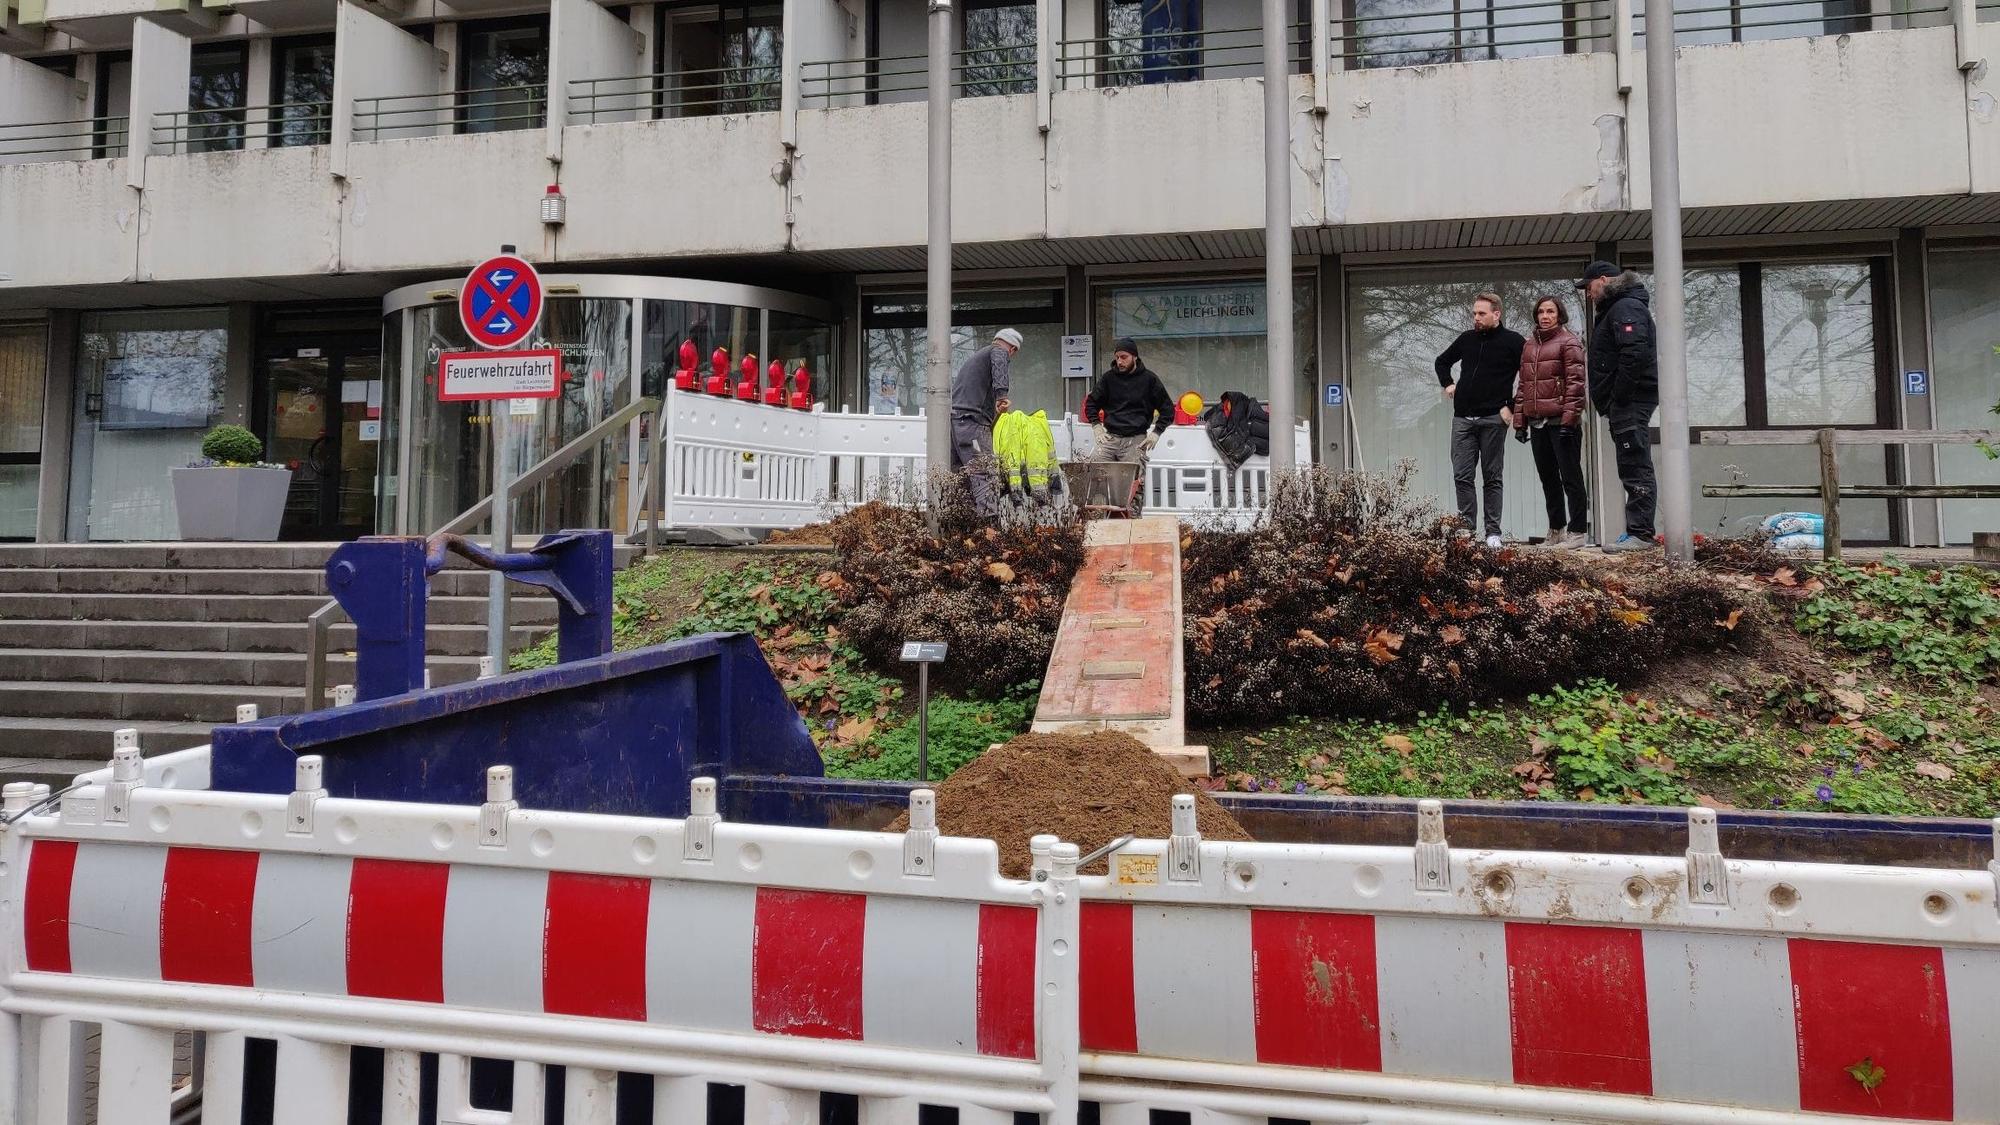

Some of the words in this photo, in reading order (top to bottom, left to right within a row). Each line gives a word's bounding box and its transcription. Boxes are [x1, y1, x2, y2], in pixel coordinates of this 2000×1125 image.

[1177, 305, 1255, 318] LEICHLINGEN
[559, 349, 605, 357] EICHLINGEN
[447, 361, 553, 379] Feuerwehrzufahrt
